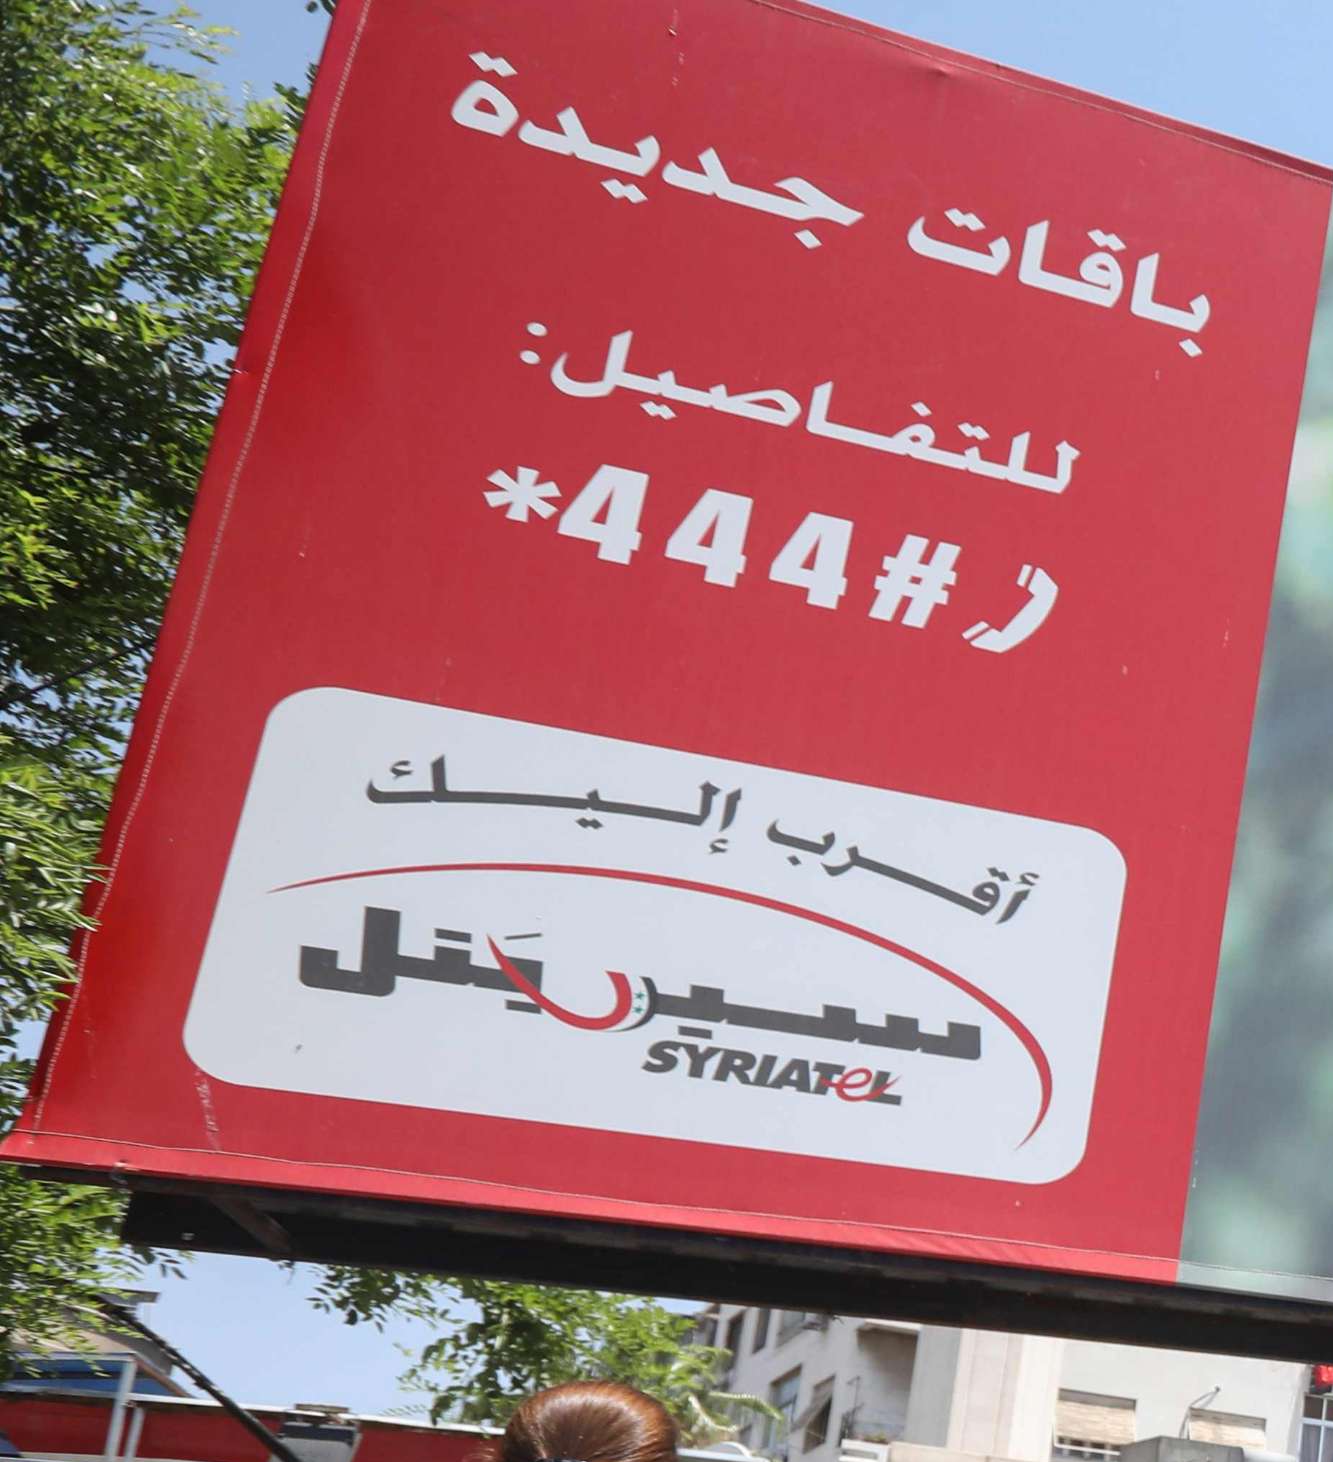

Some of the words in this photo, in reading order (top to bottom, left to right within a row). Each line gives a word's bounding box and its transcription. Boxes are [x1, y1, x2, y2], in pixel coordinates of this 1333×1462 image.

[450, 52, 864, 249] جديدة
[907, 207, 1212, 358] باقات
[365, 754, 742, 854] إليك
[766, 819, 1040, 925] أقرب
